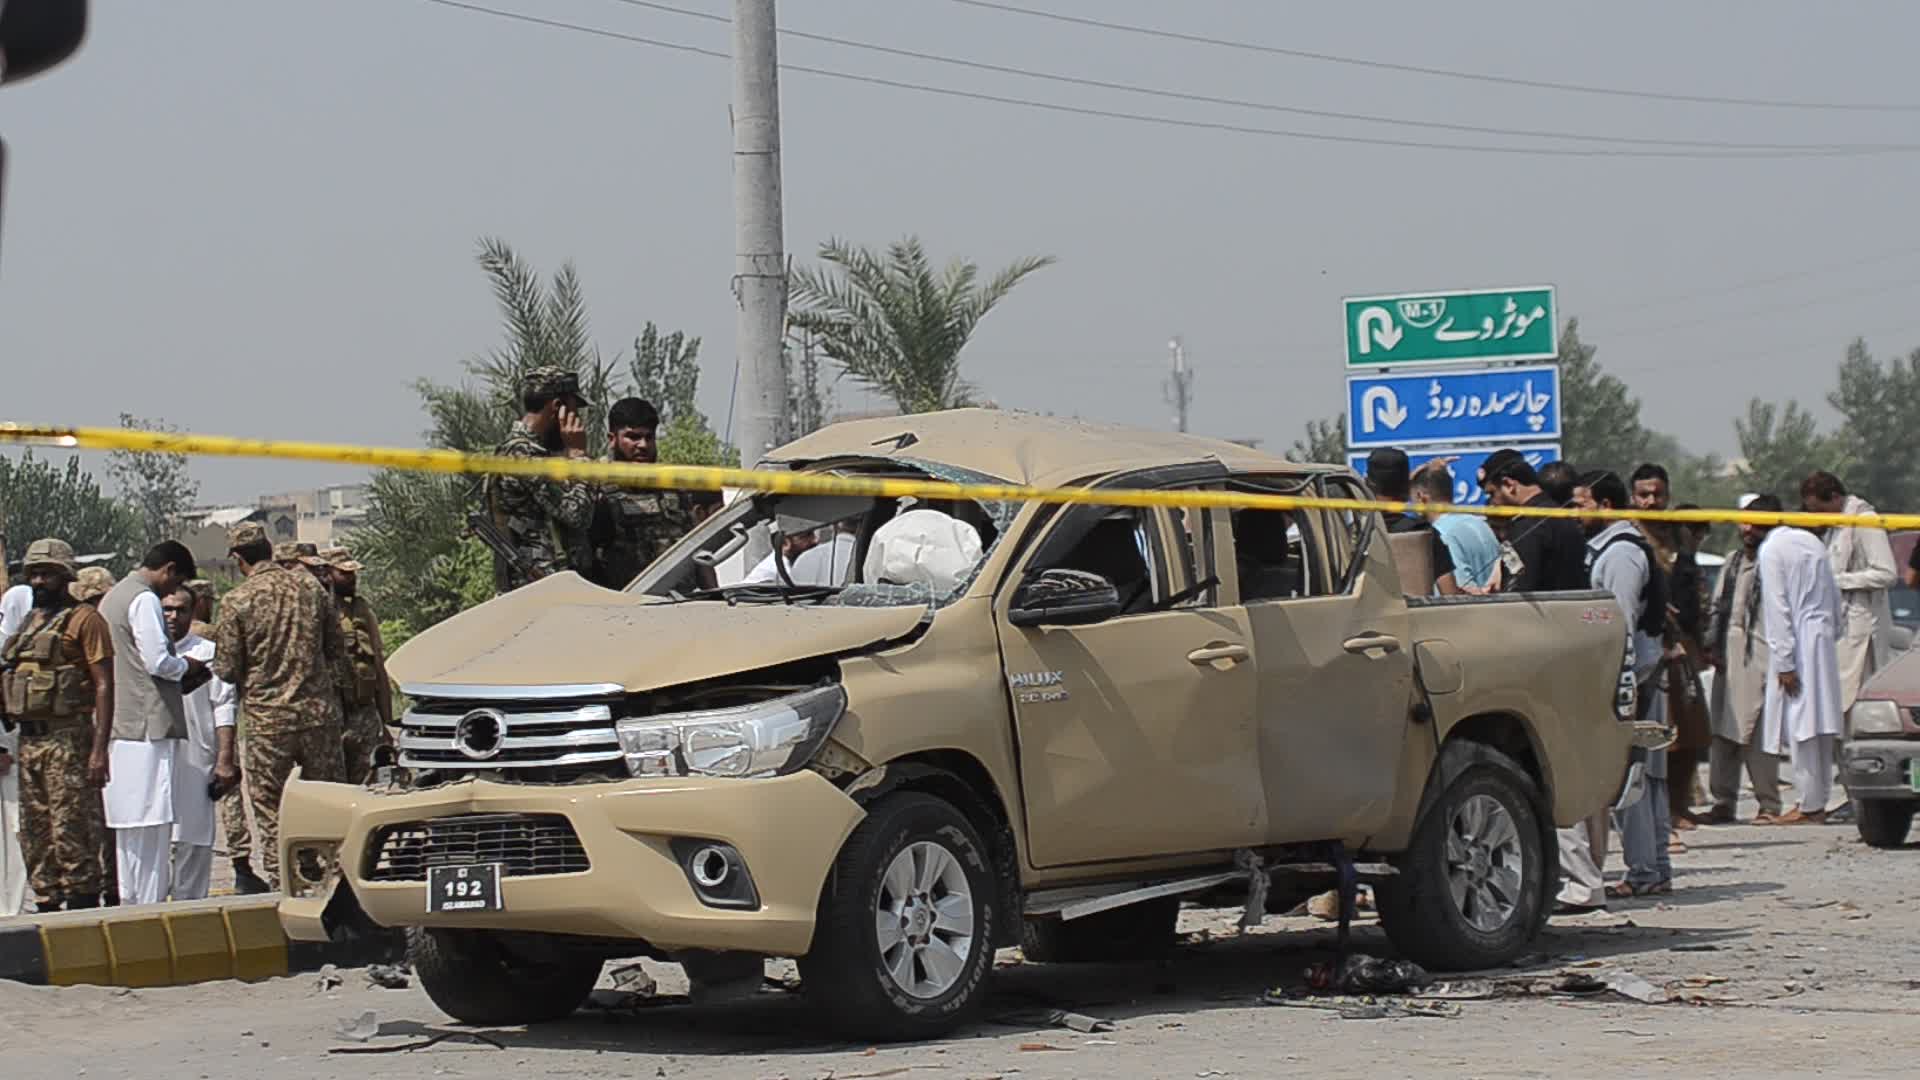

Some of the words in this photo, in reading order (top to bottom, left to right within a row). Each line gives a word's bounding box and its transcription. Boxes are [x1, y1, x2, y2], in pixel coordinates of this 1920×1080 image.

[1404, 302, 1438, 318] M-1
[1434, 296, 1546, 342] موٹروے
[444, 880, 483, 897] 192
